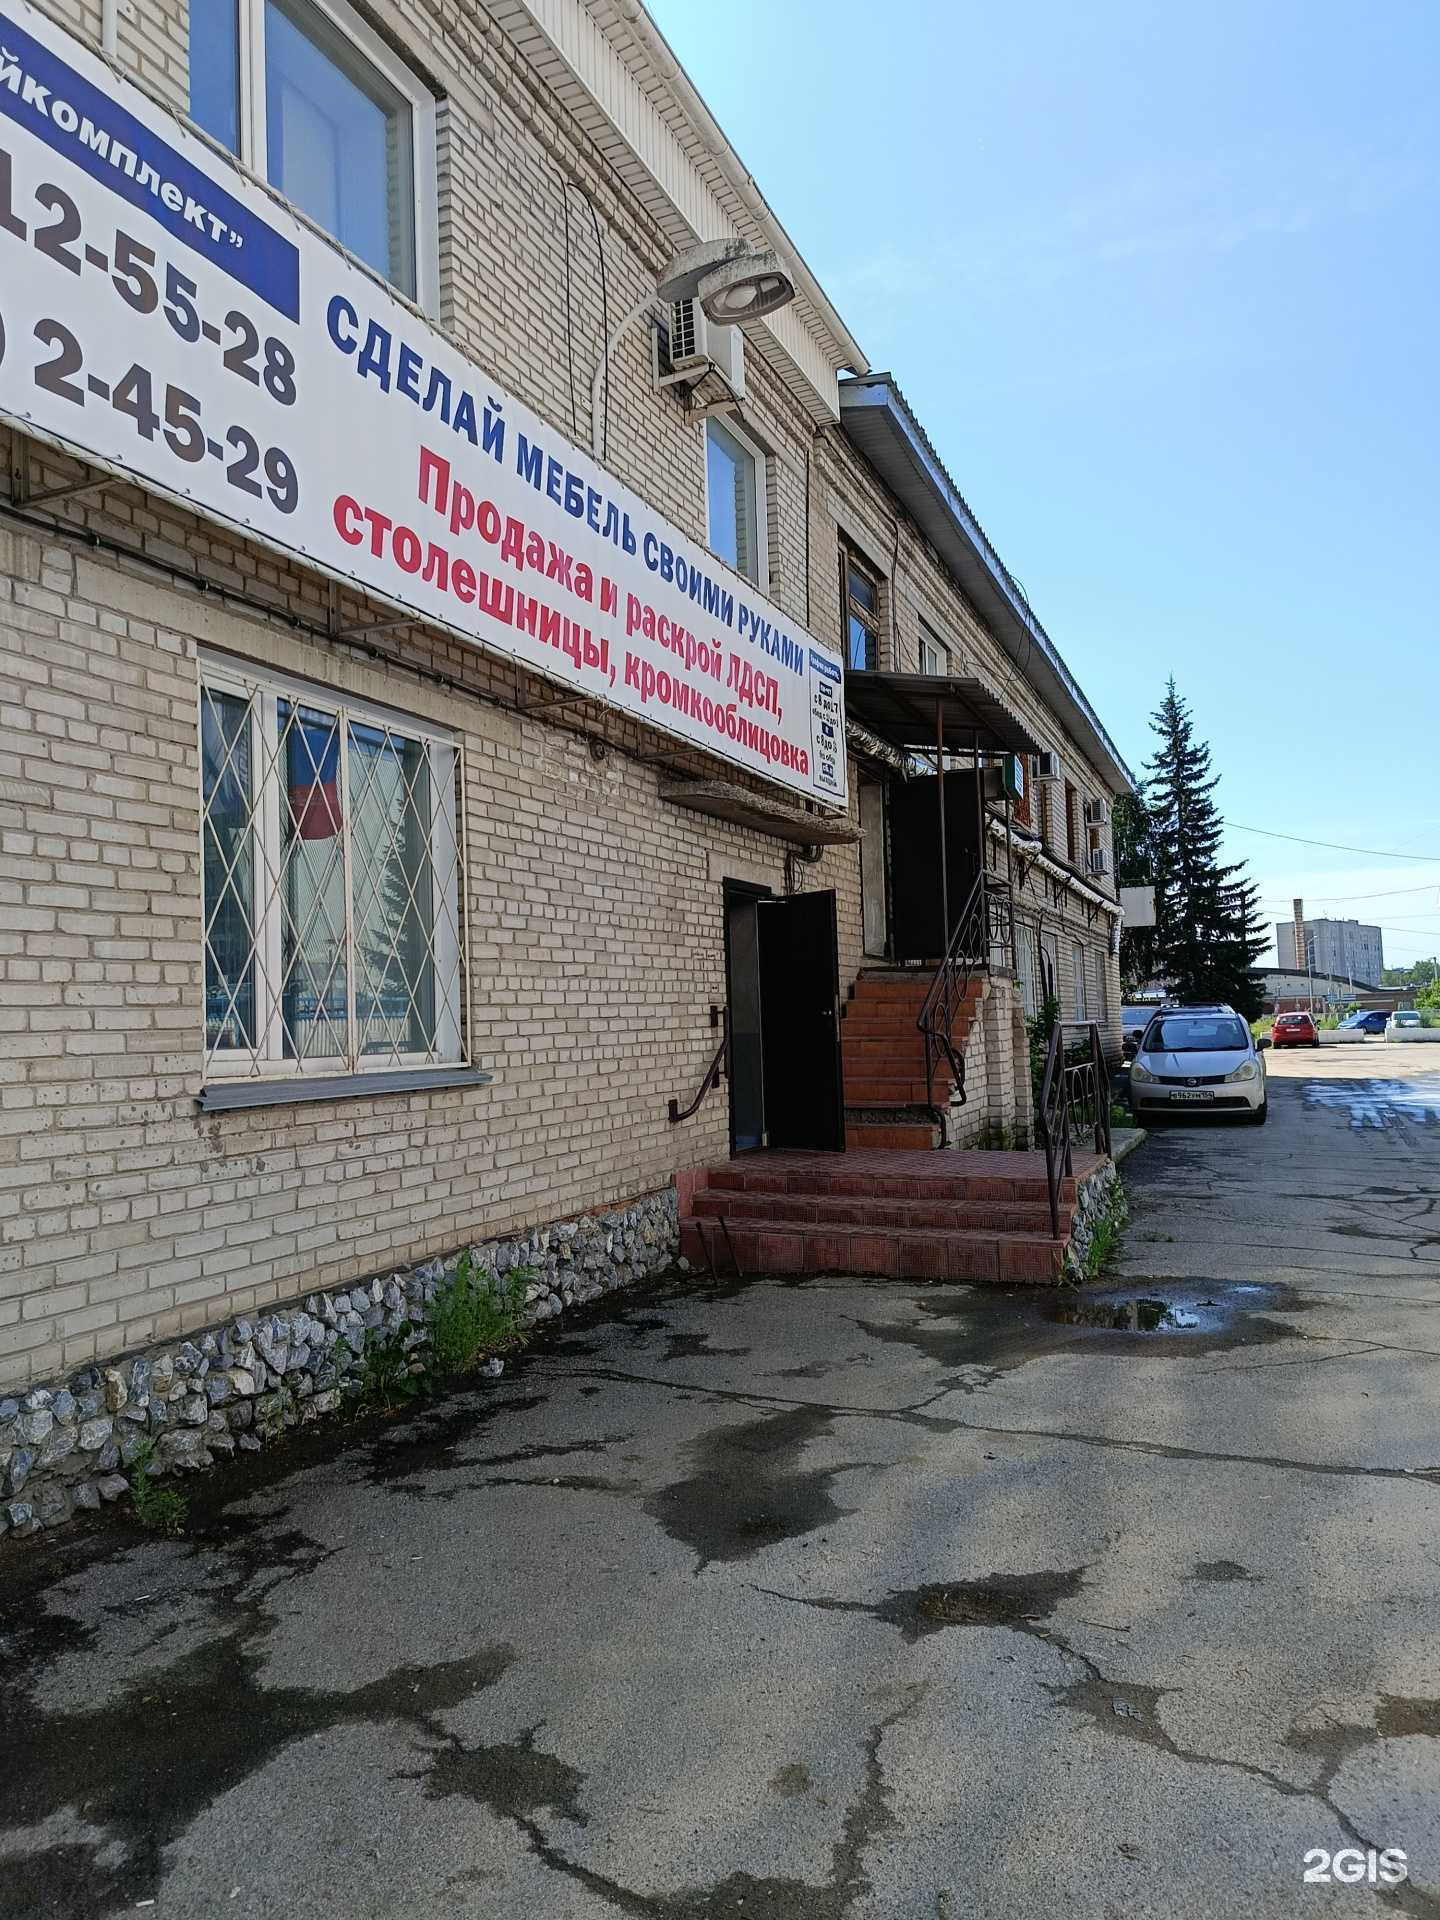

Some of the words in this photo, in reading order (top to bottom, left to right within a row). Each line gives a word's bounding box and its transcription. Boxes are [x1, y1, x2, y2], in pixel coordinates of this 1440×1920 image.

[33, 318, 299, 514] 2-45-29
[326, 294, 505, 464] СДЕЛАЙ
[516, 432, 637, 557] МЕБЕЛЬ
[643, 531, 734, 628] СВОИМИ
[738, 602, 804, 676] РУКАМИ
[333, 495, 616, 688] столешницы,
[624, 651, 809, 776] кромкооблицовка
[418, 446, 593, 603] Продажа
[600, 576, 618, 618] и
[626, 592, 723, 682] раскрой
[726, 652, 783, 725] ЛДСП,
